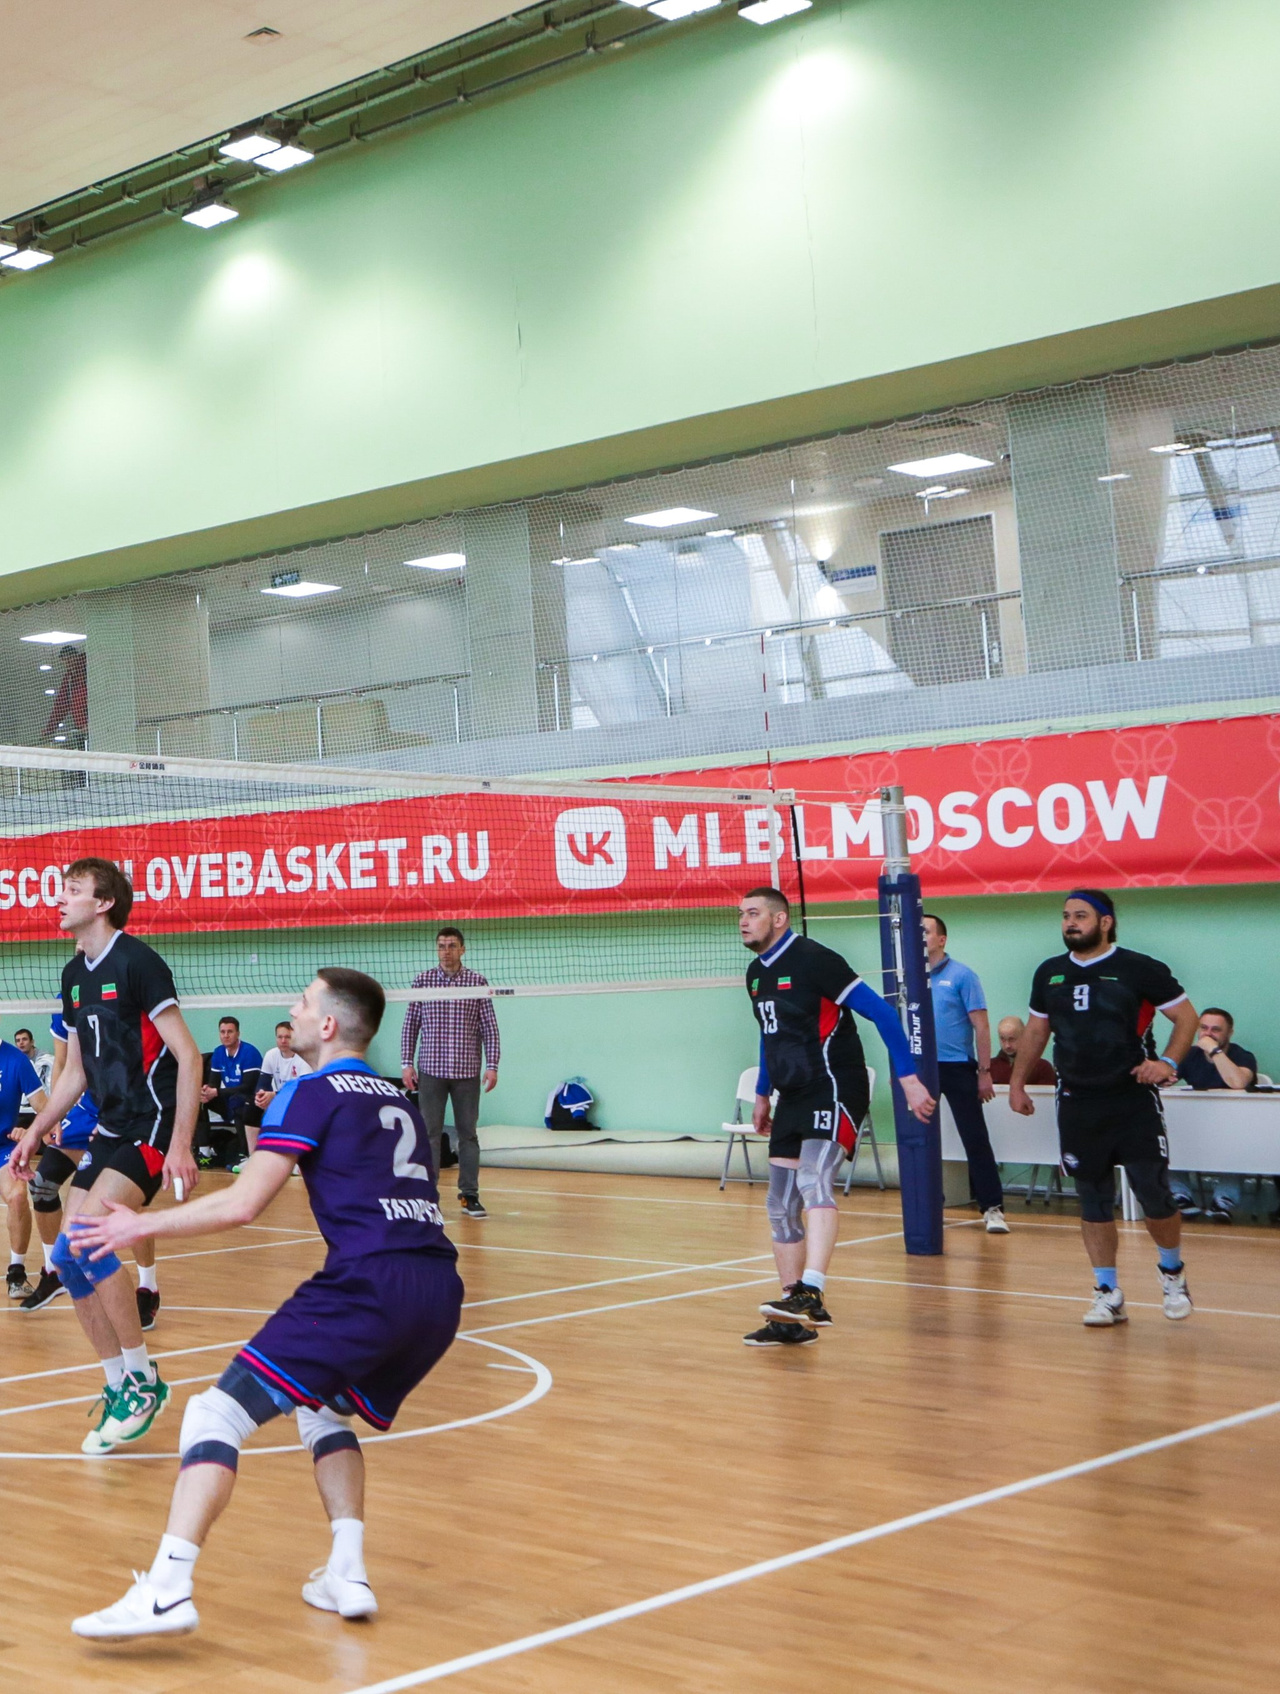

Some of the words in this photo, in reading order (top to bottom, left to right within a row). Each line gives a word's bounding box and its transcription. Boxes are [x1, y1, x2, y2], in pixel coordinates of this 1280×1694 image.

[1073, 984, 1089, 1011] 9
[758, 1001, 778, 1034] 13
[87, 1014, 100, 1057] 7
[813, 1111, 832, 1129] 13
[378, 1105, 429, 1181] 2
[1157, 1135, 1168, 1157] 9
